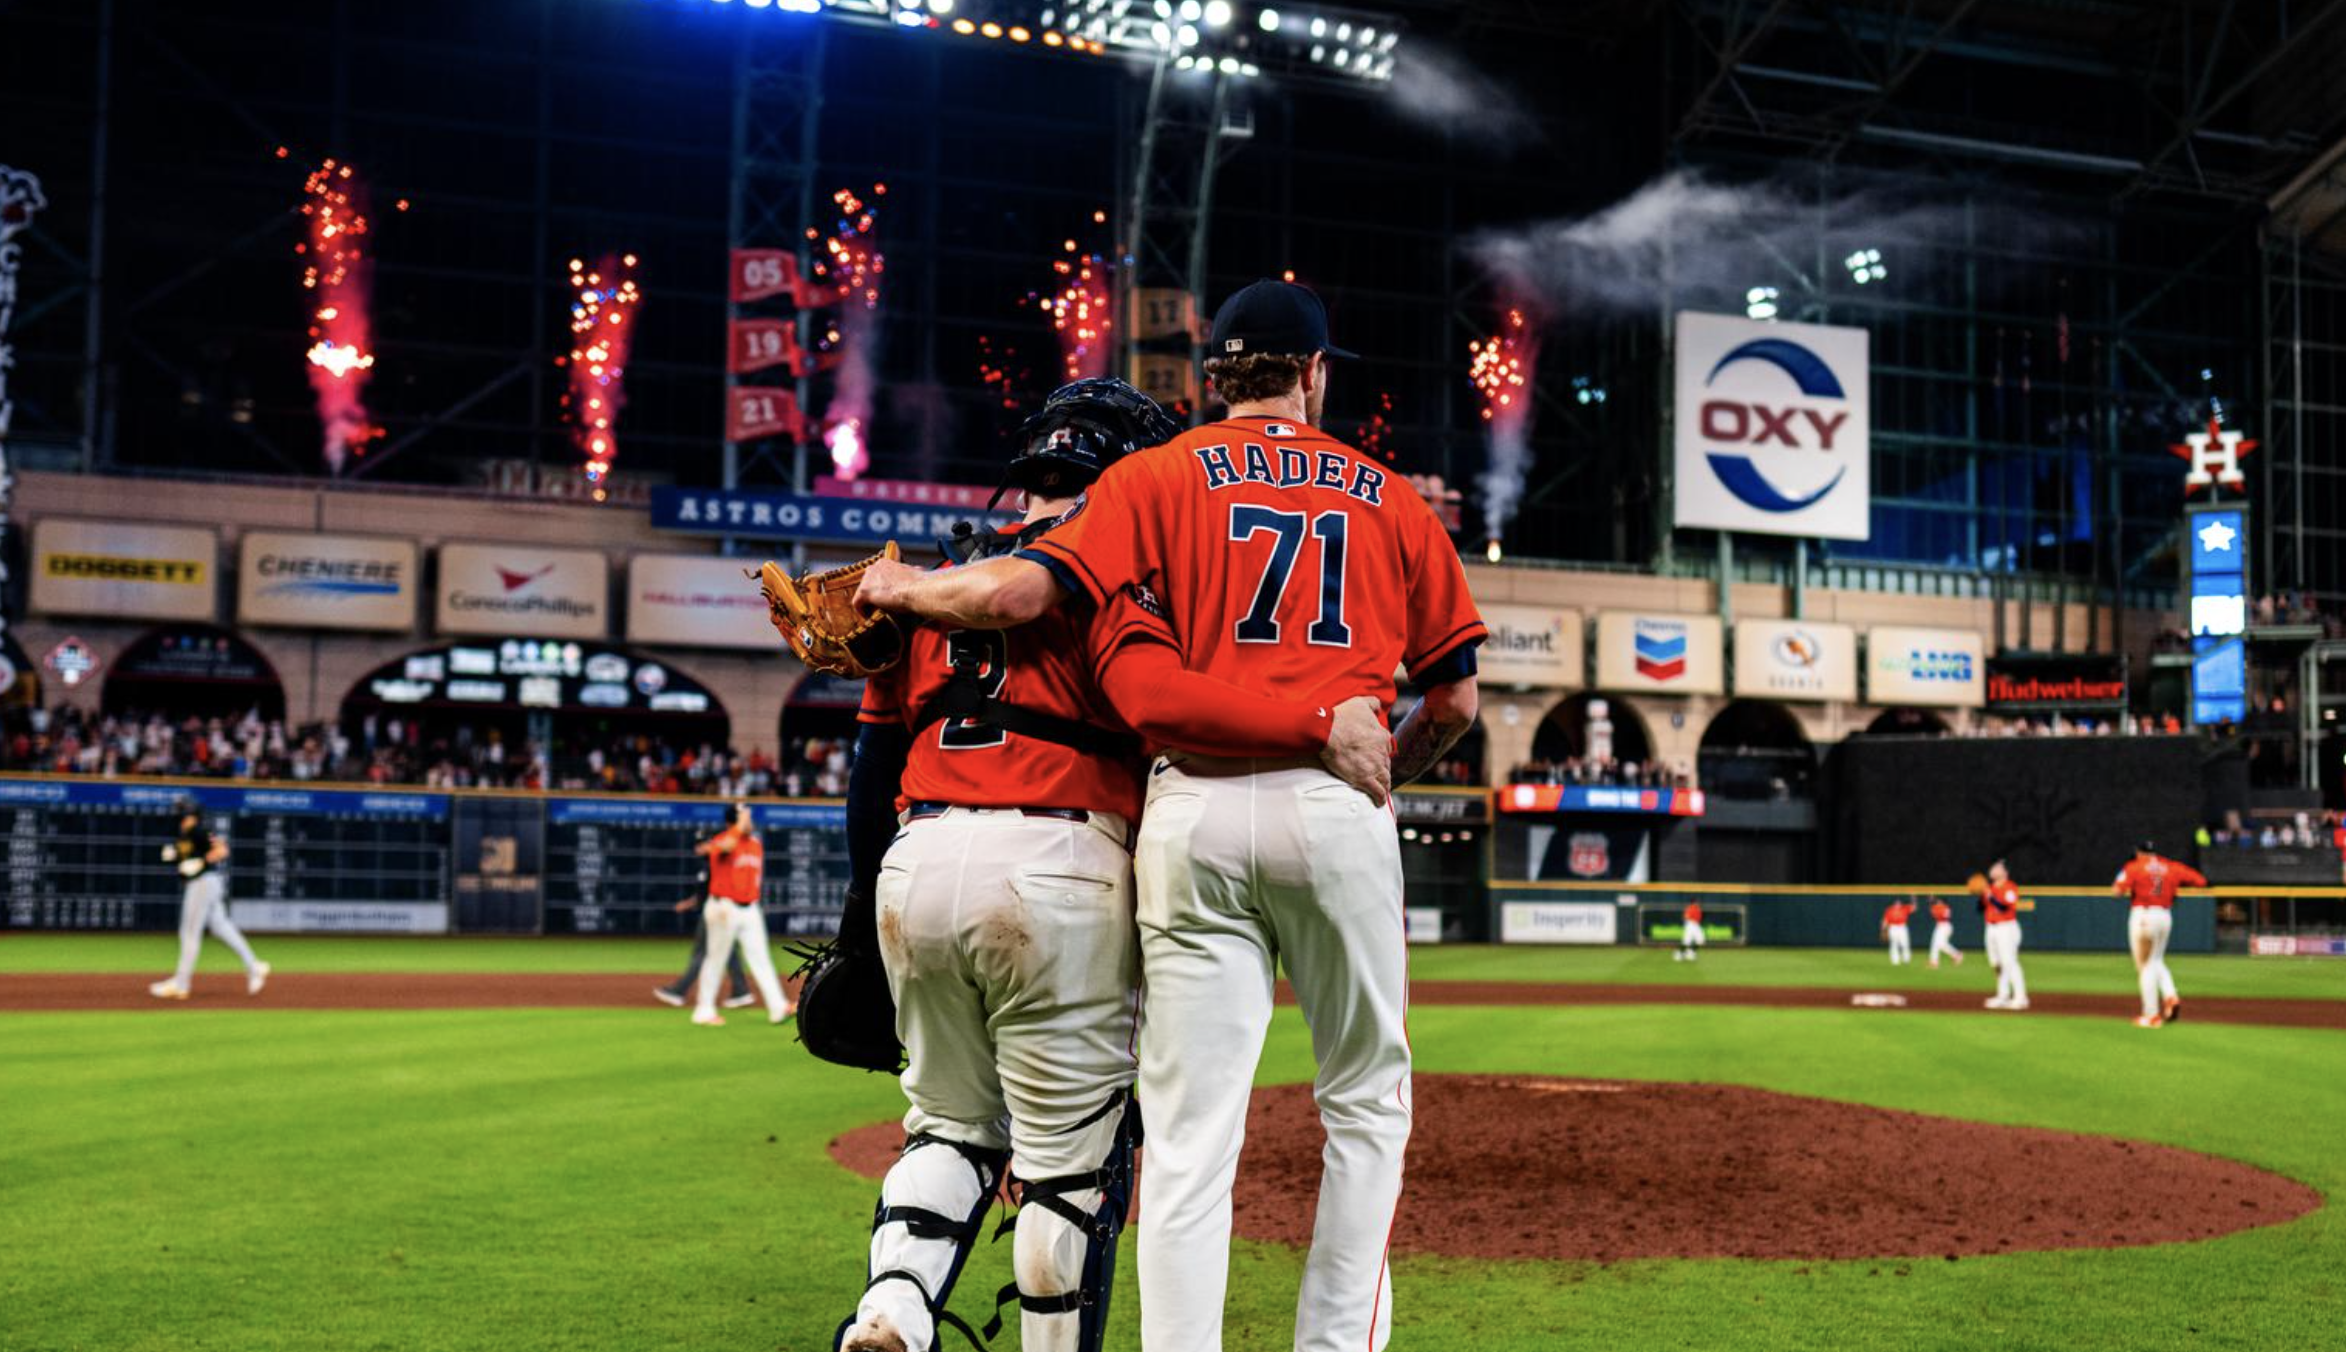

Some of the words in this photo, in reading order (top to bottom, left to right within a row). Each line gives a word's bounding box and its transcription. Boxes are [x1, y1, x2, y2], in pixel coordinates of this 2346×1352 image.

[744, 258, 782, 287] 05
[746, 331, 782, 358] 19
[742, 398, 775, 424] 21
[1700, 401, 1848, 450] OXY
[1194, 442, 1386, 507] HADER
[678, 498, 823, 528] ASTROS
[50, 556, 197, 582] DOGGETT
[256, 555, 401, 581] CHENIERE
[1228, 503, 1352, 648] 71
[449, 591, 596, 617] ConocoPhillips
[1486, 624, 1554, 653] eliant
[939, 629, 1007, 749] 2
[1989, 674, 2125, 701] Budweiser
